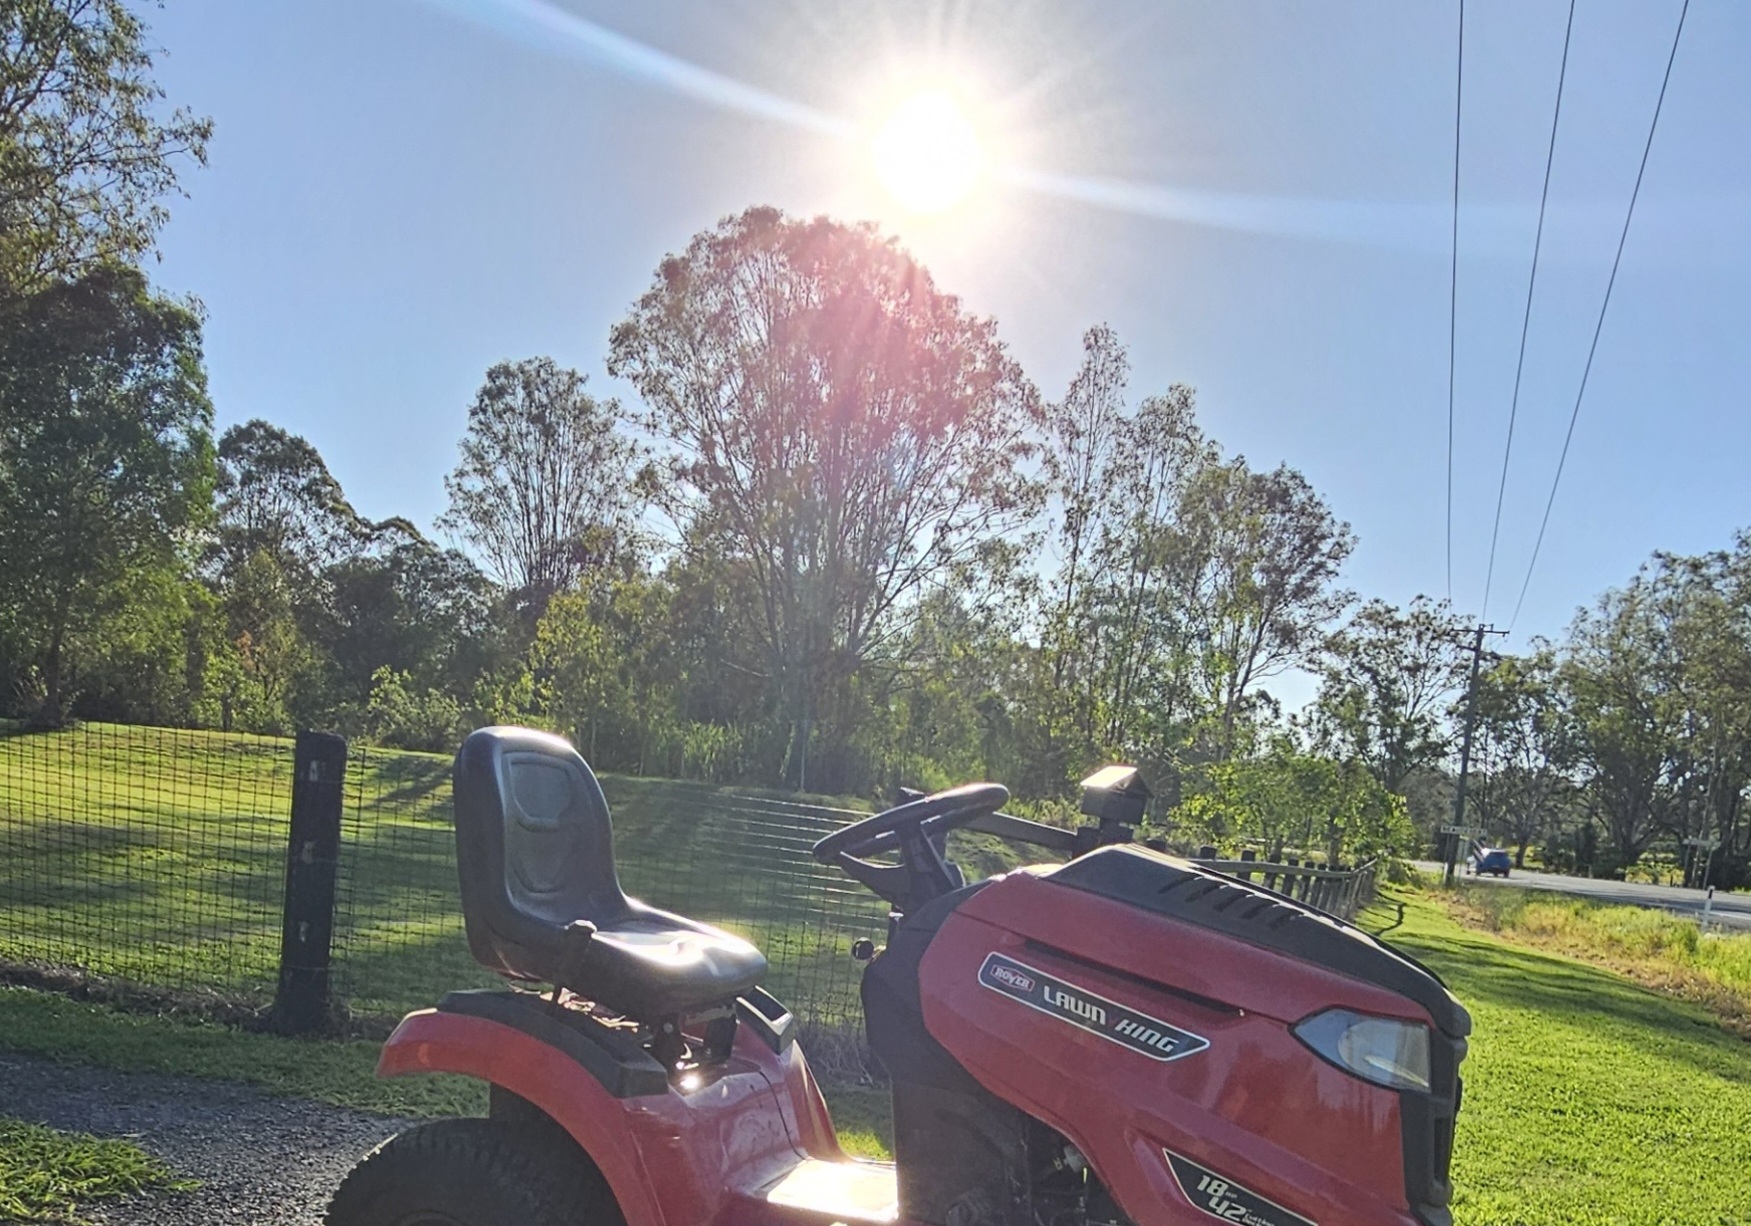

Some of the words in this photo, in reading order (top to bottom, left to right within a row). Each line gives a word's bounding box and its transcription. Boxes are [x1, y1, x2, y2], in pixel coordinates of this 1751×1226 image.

[994, 966, 1031, 989] ROVER
[1043, 985, 1107, 1026] LAWN
[1114, 1018, 1180, 1053] KING
[1197, 1174, 1229, 1198] 18
